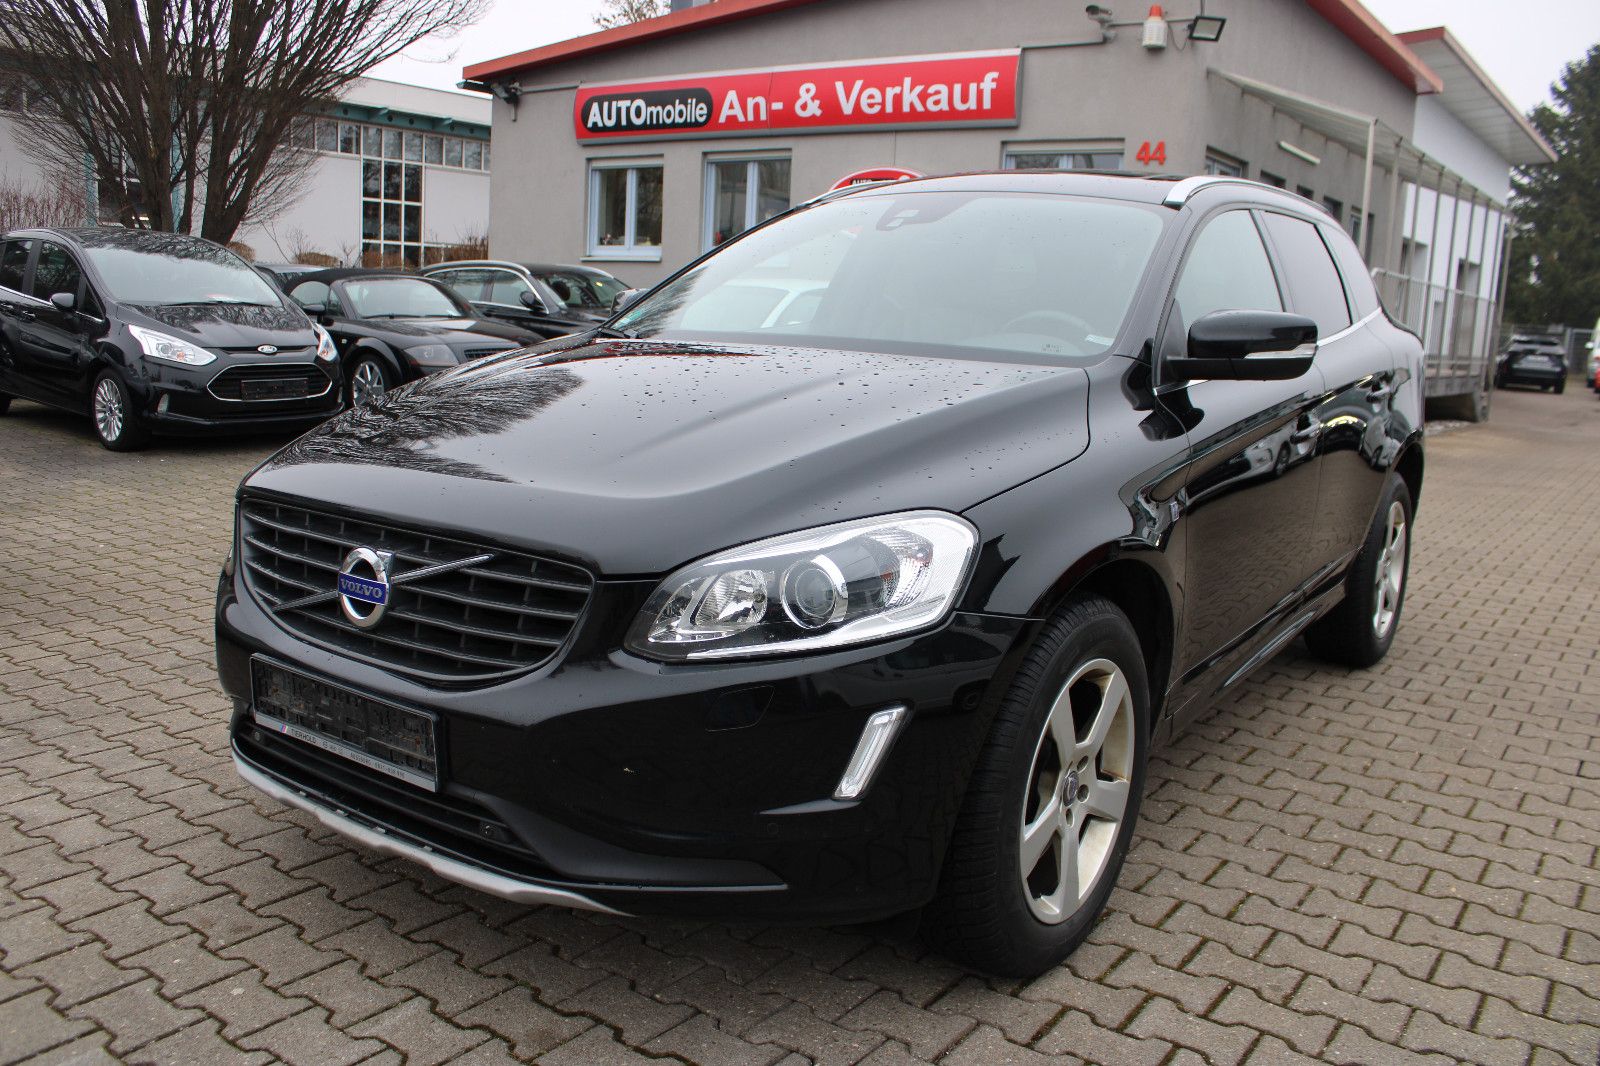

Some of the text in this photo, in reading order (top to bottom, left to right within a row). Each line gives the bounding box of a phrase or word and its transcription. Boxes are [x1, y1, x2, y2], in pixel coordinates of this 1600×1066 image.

[586, 72, 999, 128] AUTOmobile An- & Verkauf
[1136, 141, 1167, 166] 44
[341, 578, 383, 598] VOLVO
